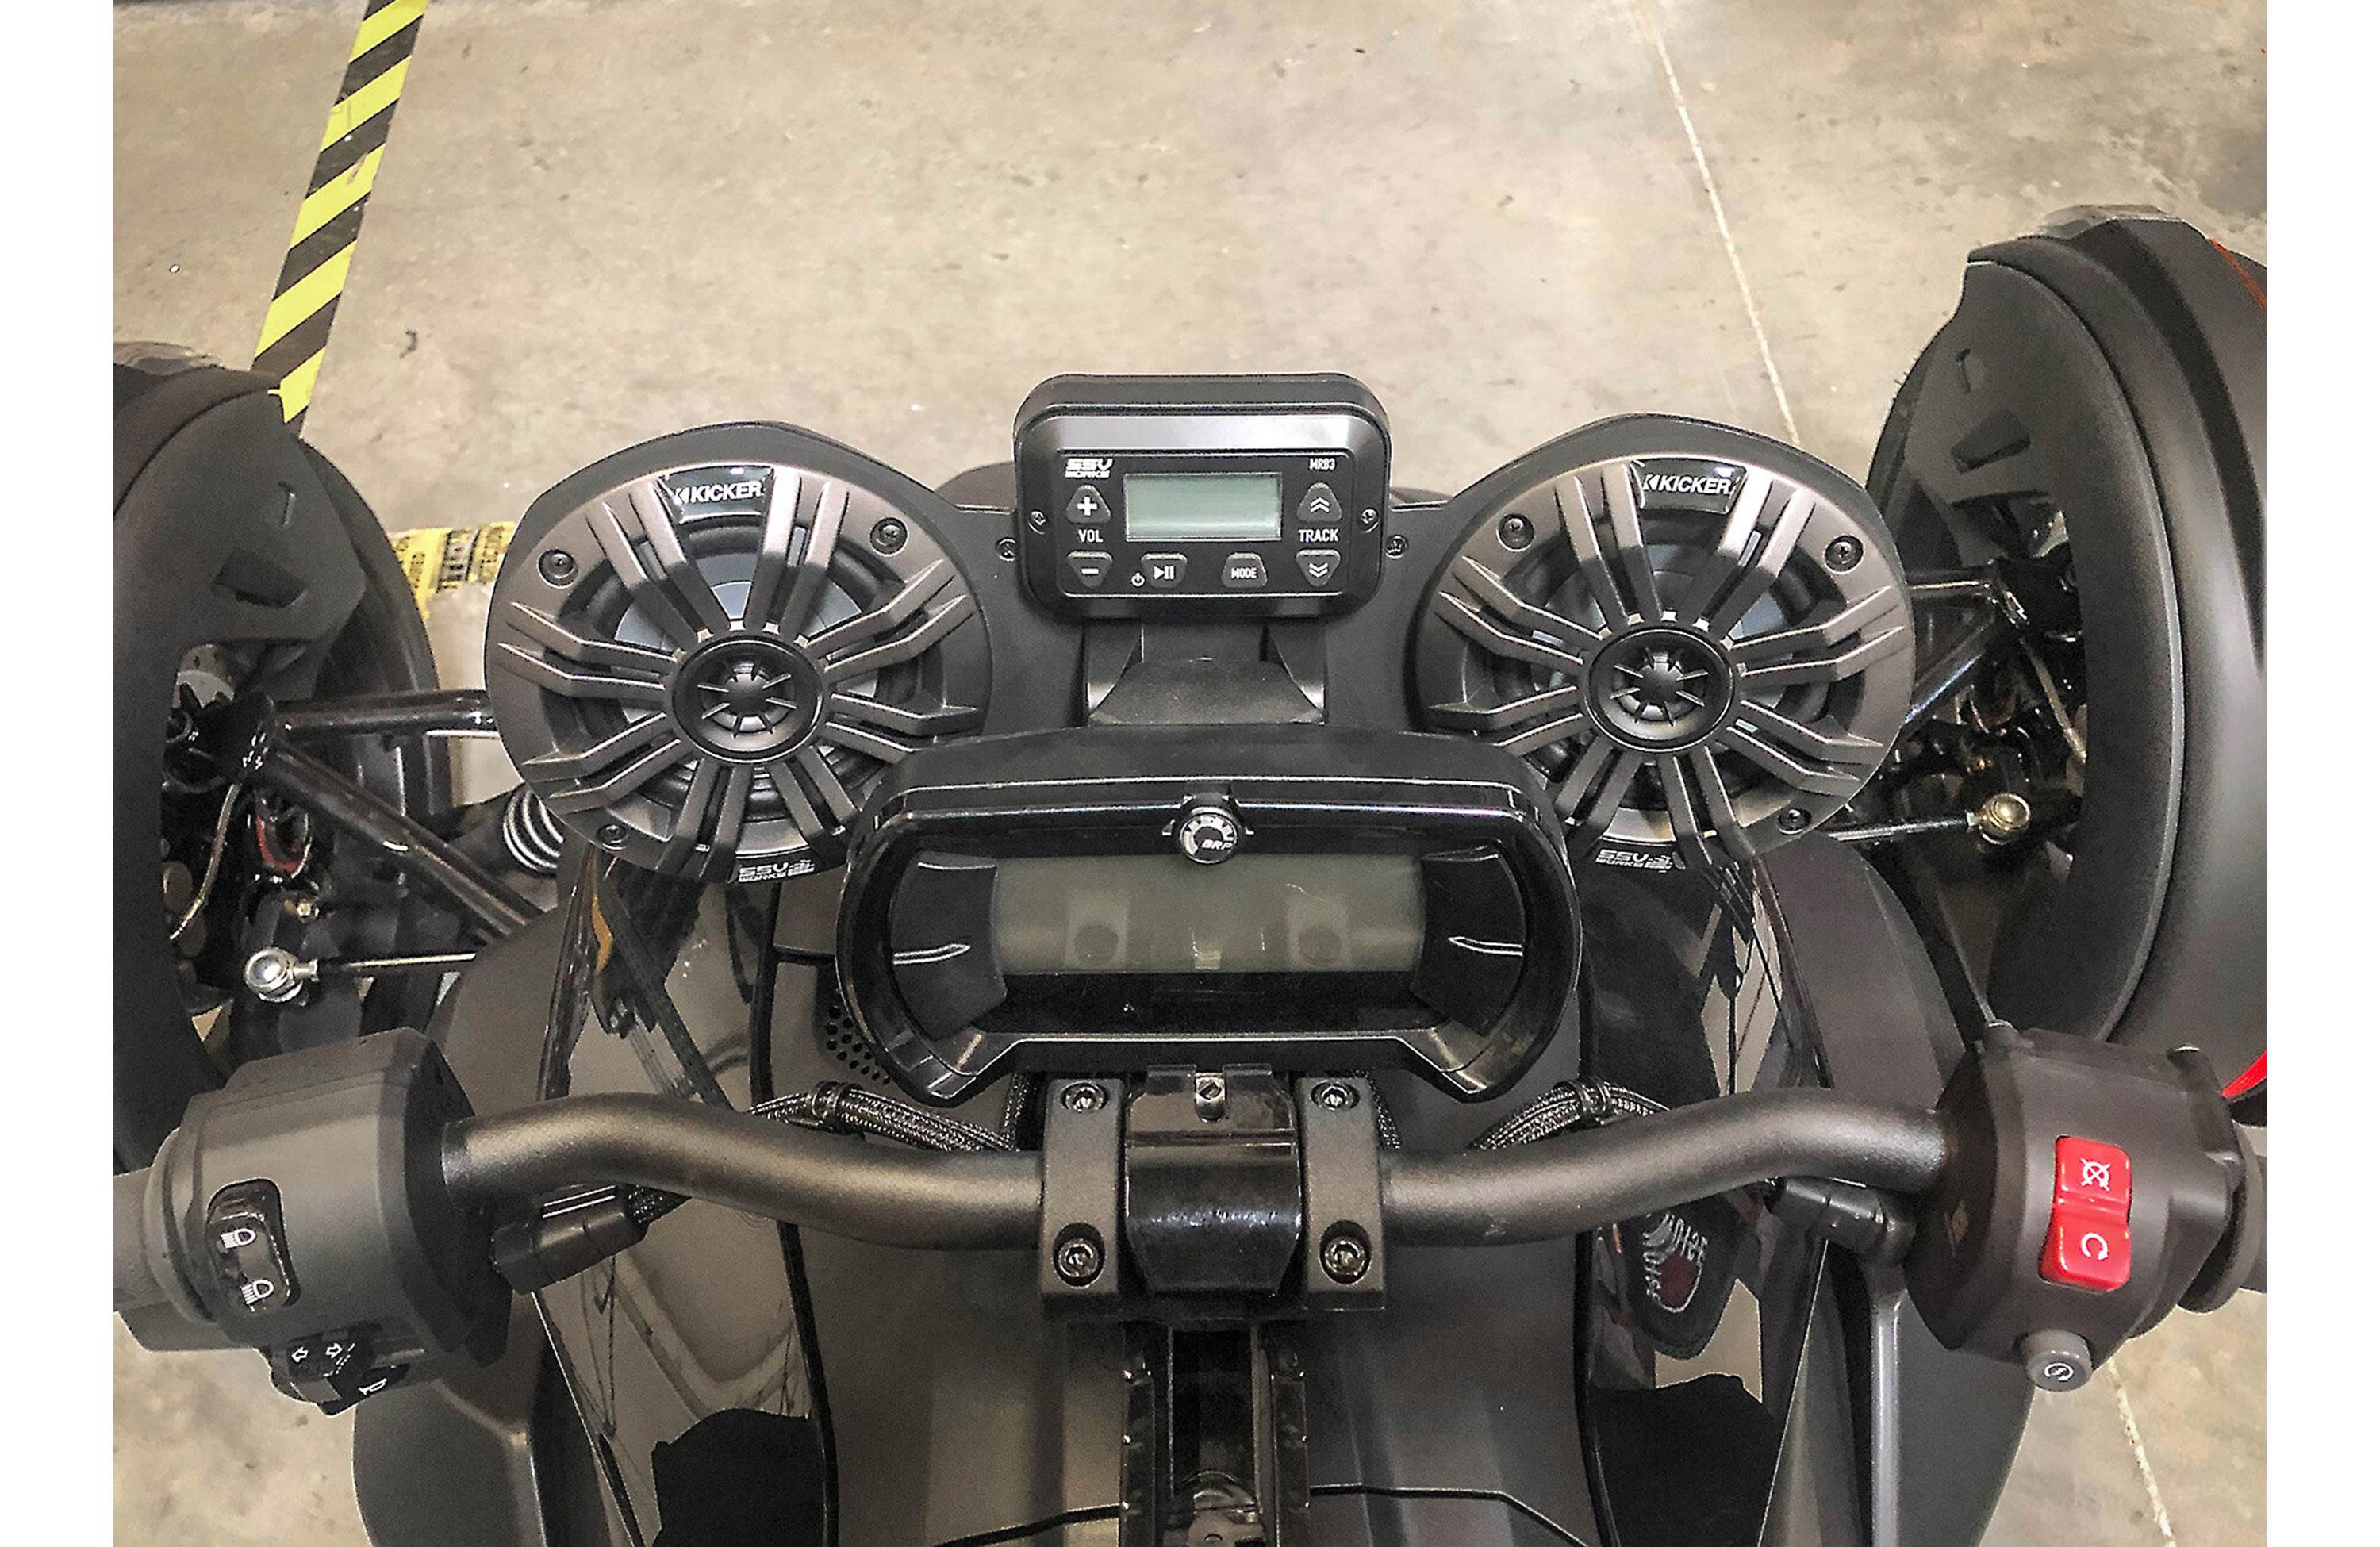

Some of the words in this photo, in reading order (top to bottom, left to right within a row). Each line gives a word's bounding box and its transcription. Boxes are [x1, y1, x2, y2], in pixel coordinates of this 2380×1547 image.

[1065, 458, 1114, 470] SSV
[690, 481, 762, 503] KICKER
[1657, 474, 1732, 496] KICKER
[1077, 529, 1104, 543] VOL
[1298, 528, 1340, 543] TRACK
[1230, 566, 1257, 580] MODE
[1598, 849, 1649, 862] SSV
[739, 862, 789, 876] SSV
